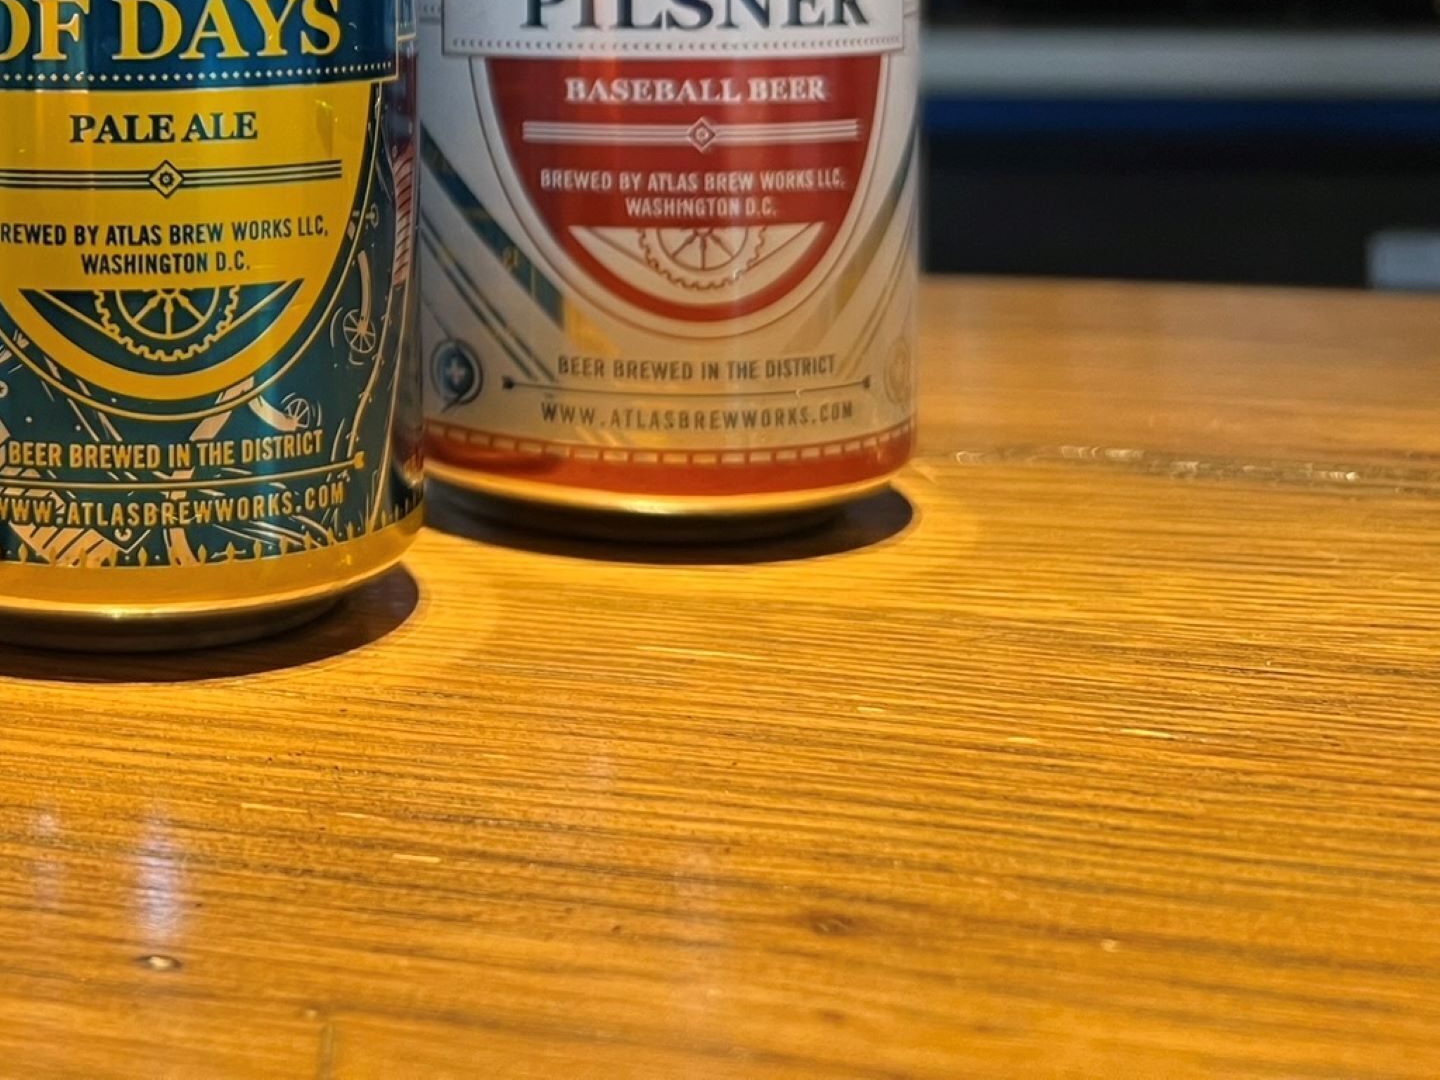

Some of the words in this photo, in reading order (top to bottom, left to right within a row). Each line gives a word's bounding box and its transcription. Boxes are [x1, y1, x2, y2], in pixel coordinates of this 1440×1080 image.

[565, 78, 741, 105] BASEBALL
[747, 76, 827, 101] BEER
[69, 114, 175, 144] PALE
[181, 111, 258, 141] ALE
[541, 169, 611, 190] BREWED
[619, 171, 641, 190] BY
[648, 172, 698, 192] ATLAS
[704, 171, 754, 191] BREW
[761, 169, 814, 189] WORKS
[625, 197, 740, 217] WASHINGTON
[745, 196, 777, 216] D.C.
[74, 224, 100, 246] BY
[105, 224, 162, 247] ATLAS
[169, 222, 225, 245] BREW
[232, 218, 293, 241] WORKS
[81, 252, 208, 275] WASHINGTON
[215, 250, 251, 272] D.C.
[558, 356, 605, 379] BEER
[613, 359, 693, 380] BREWED
[701, 361, 719, 380] IN
[726, 360, 759, 380] THE
[765, 354, 835, 379] DISTRICT
[541, 401, 853, 431] WWW.ATLASBREWWORKS.COM
[9, 440, 62, 467] BEER
[69, 443, 160, 469] BREWED
[168, 443, 191, 468] IN
[197, 440, 236, 466] THE
[241, 429, 324, 463] DISTRICT
